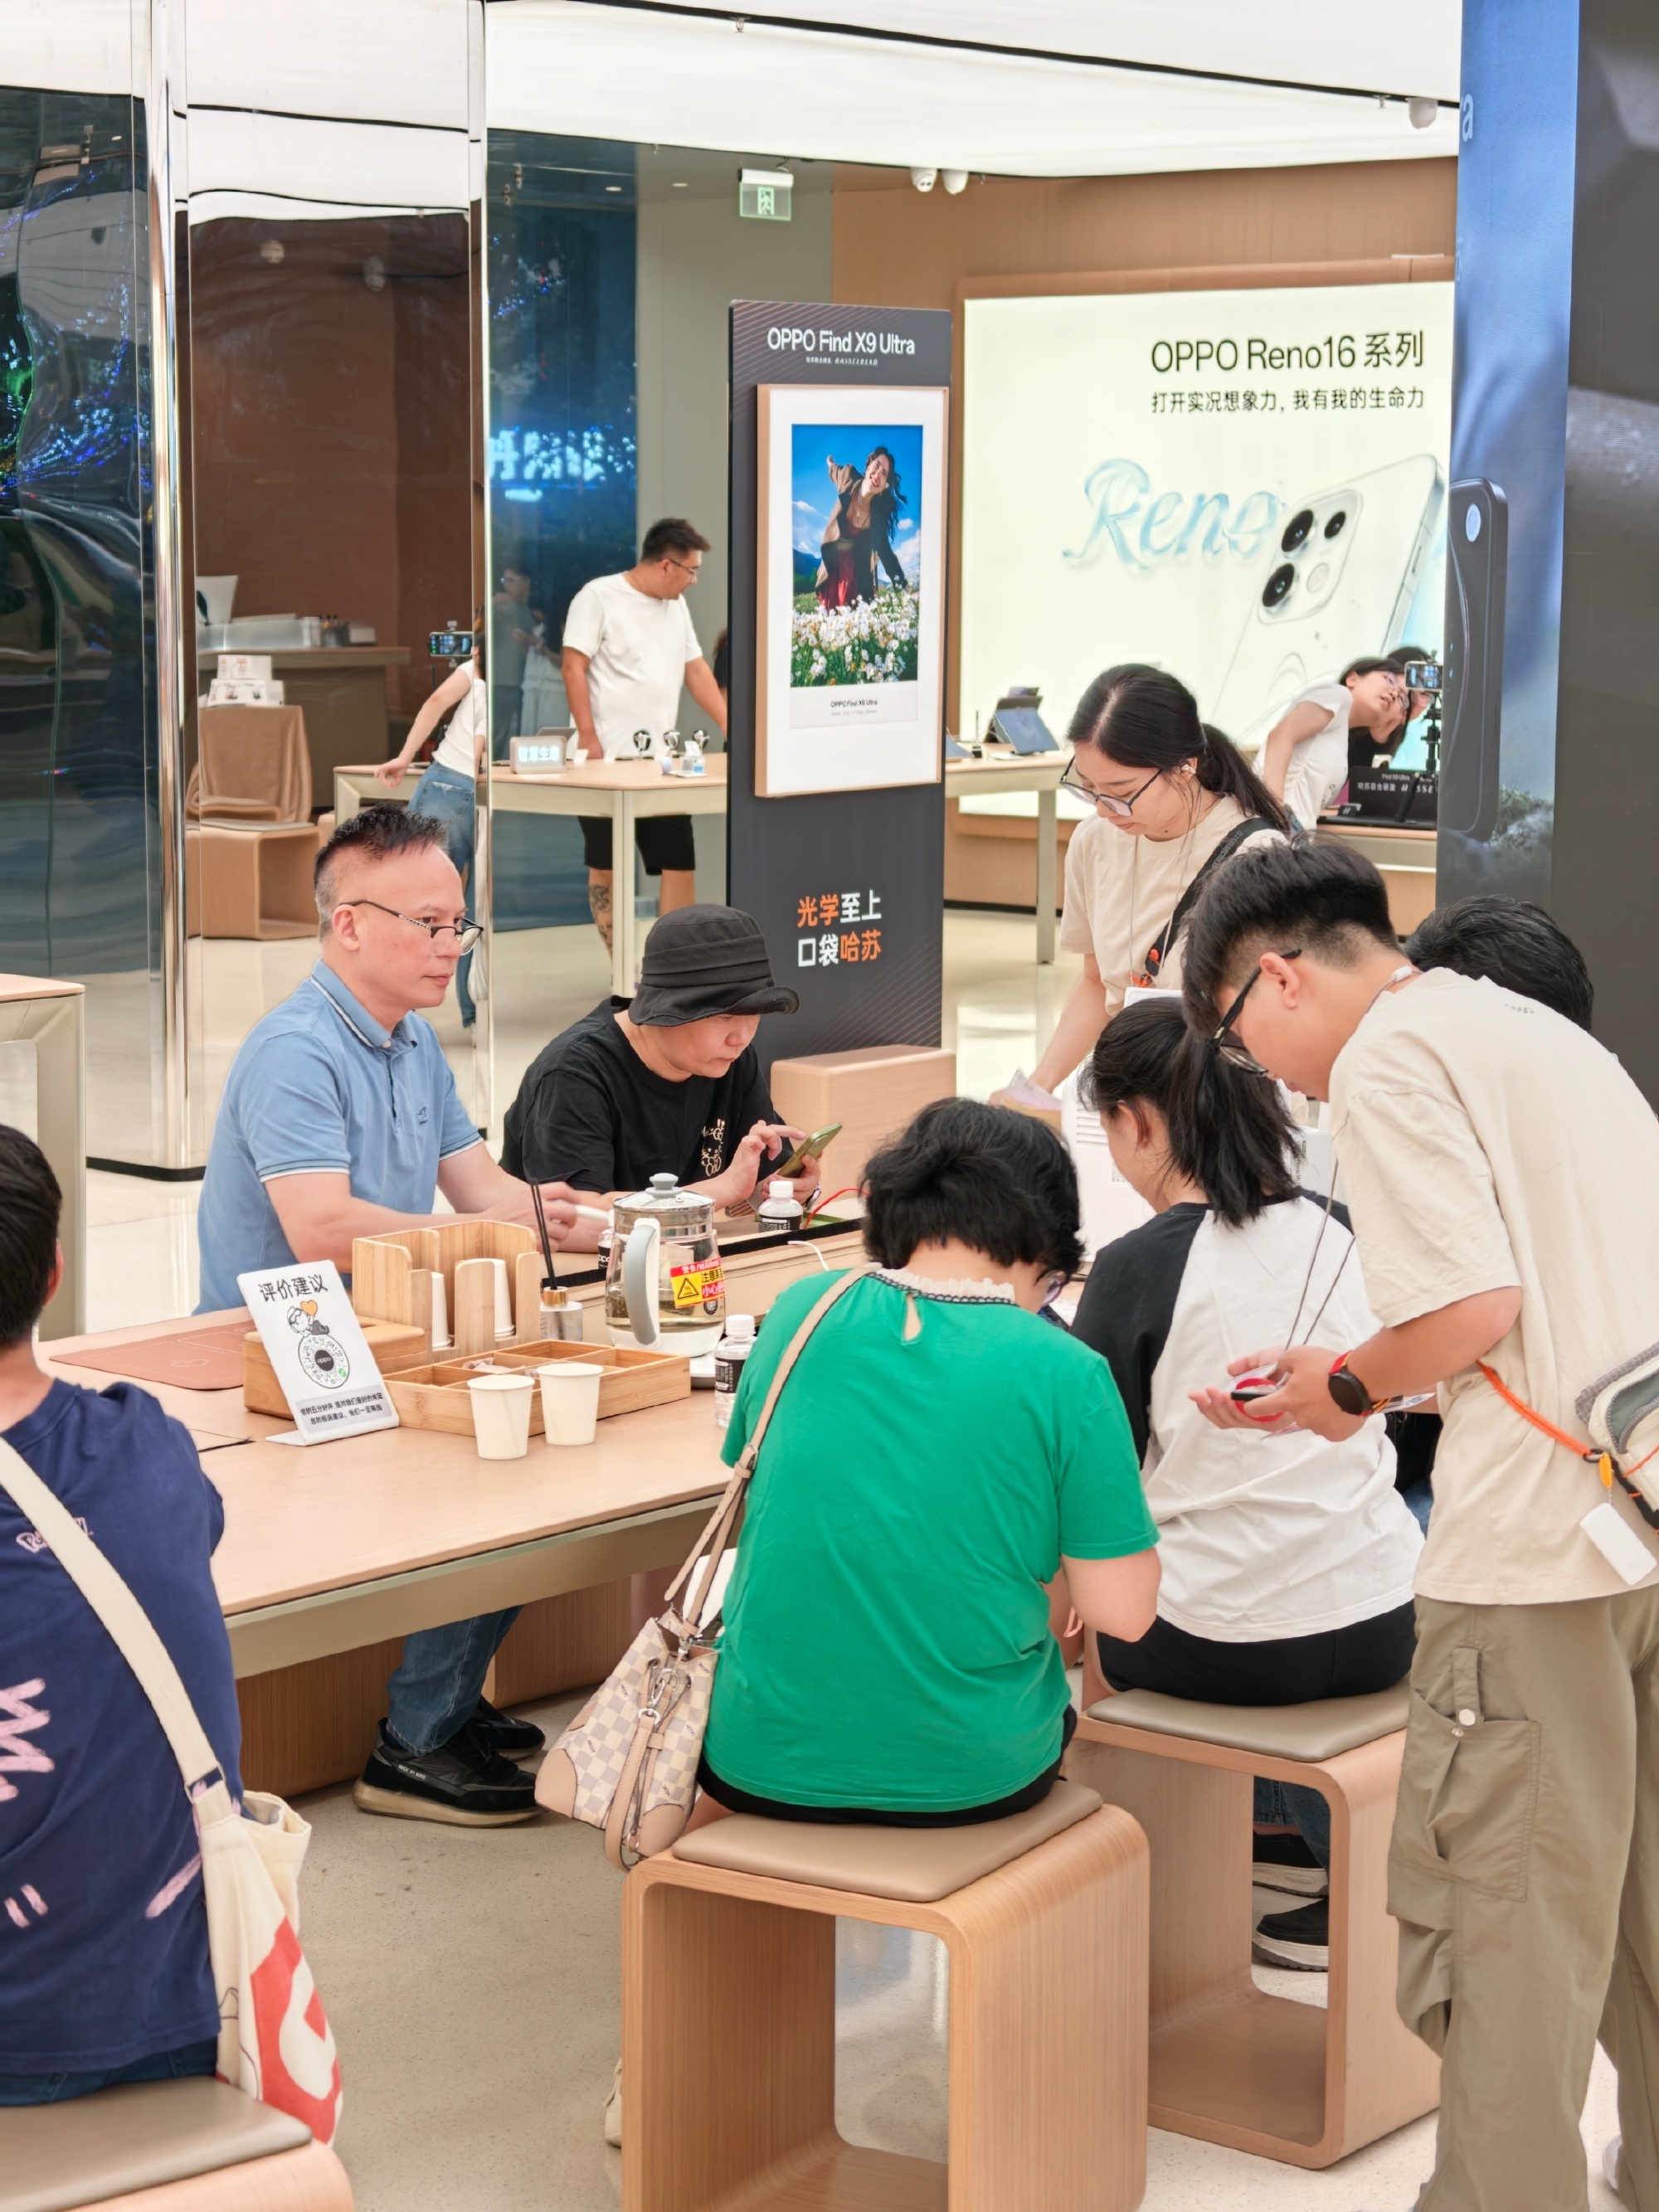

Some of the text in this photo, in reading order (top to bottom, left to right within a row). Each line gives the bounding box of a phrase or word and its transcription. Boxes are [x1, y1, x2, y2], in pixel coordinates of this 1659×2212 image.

[767, 327, 915, 355] OPPO Find X9 Ultra
[1151, 330, 1423, 372] OPPO Reno16 系列
[1062, 458, 1286, 571] Reno
[797, 889, 882, 928] 光学至上
[798, 929, 882, 967] 口袋哈苏
[258, 1274, 328, 1302] 评价建议
